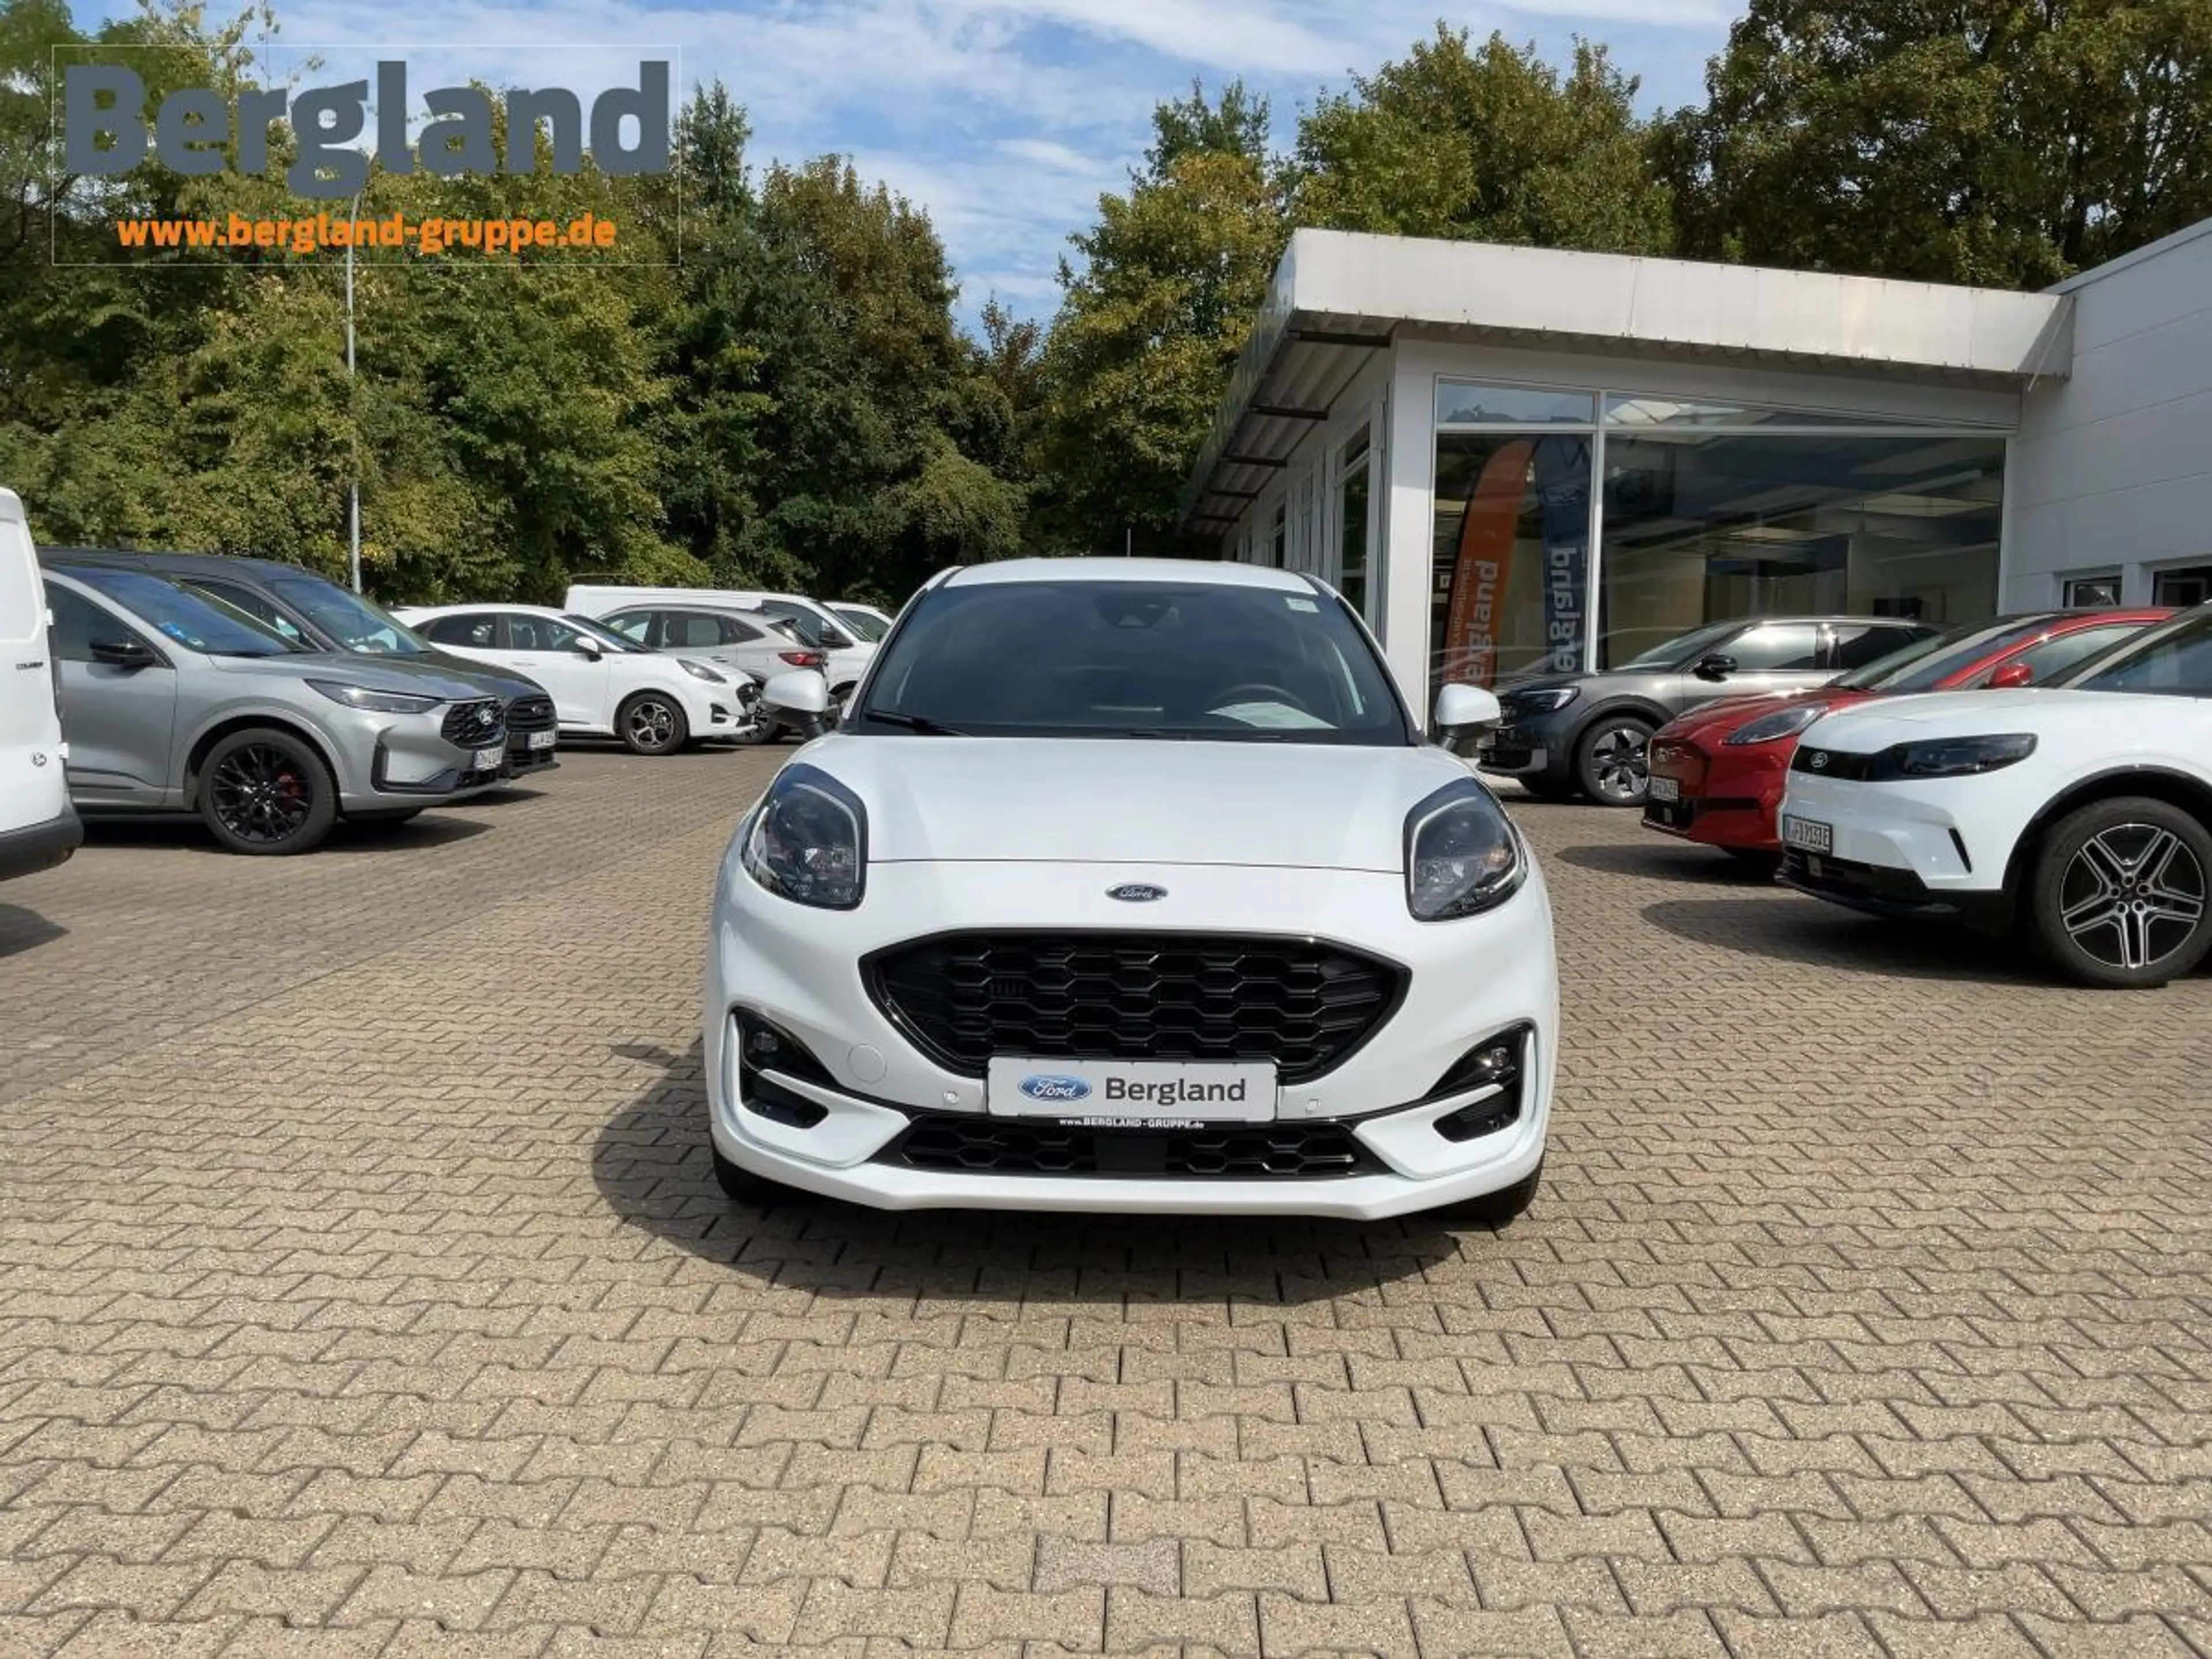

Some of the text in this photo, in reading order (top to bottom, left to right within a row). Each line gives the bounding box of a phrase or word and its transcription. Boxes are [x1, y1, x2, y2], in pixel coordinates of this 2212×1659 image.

[1465, 560, 1498, 681] ergland
[1033, 1077, 1246, 1106] Ford Bergland
[1059, 1117, 1205, 1129] www.BERGLAND-GRUPPE.de
